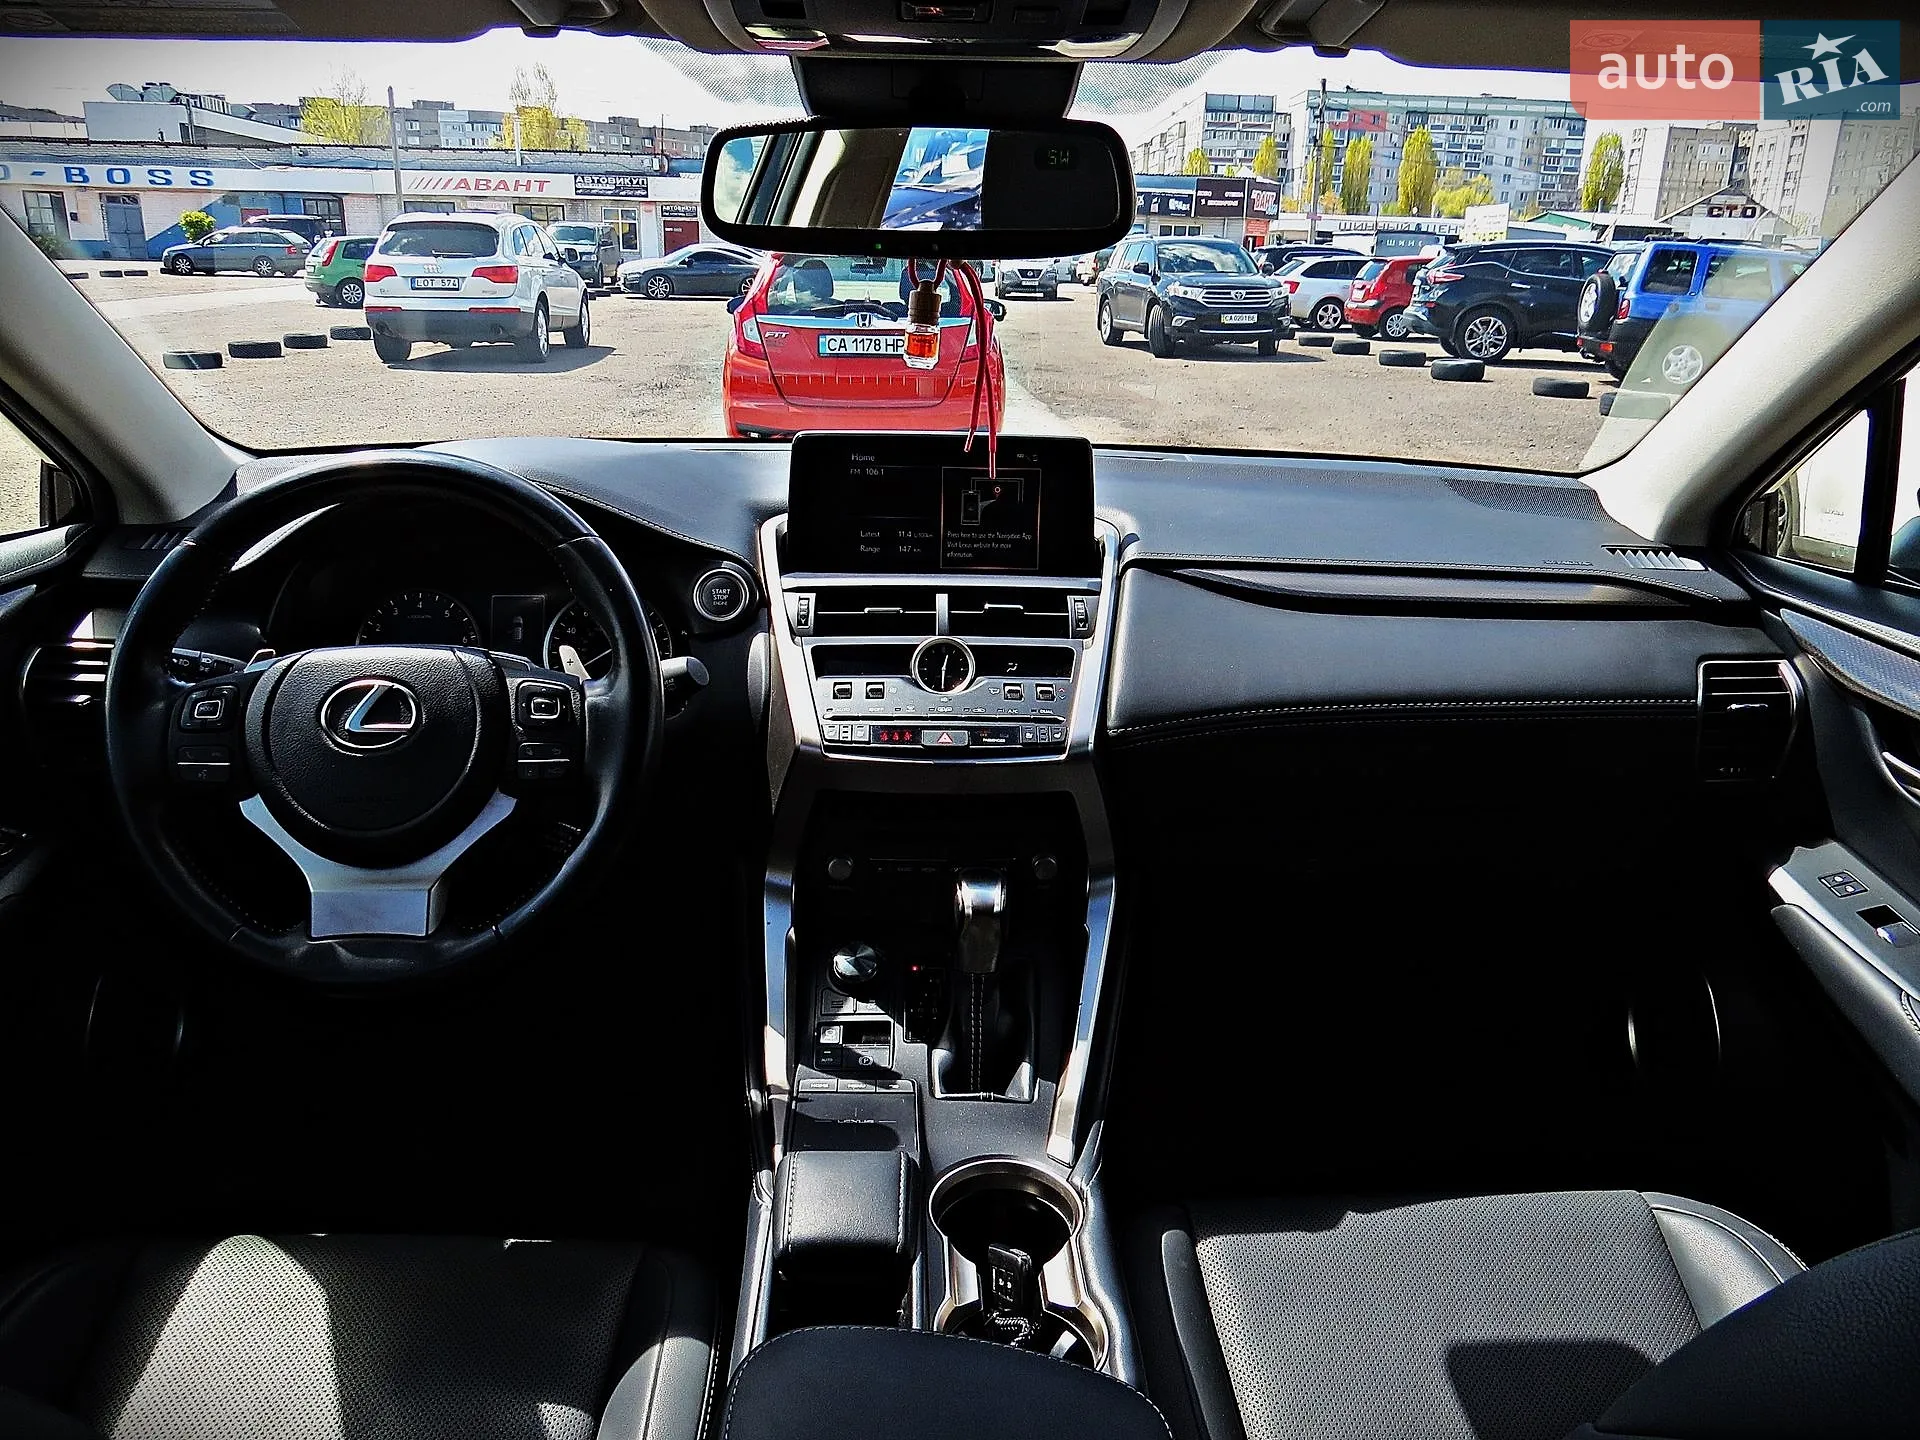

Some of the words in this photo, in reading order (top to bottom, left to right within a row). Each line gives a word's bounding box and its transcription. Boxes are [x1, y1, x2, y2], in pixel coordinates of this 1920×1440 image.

[453, 178, 551, 193] АВАНТ
[575, 175, 647, 186] АВТОВИКУП
[416, 279, 436, 287] LOT
[827, 338, 848, 352] CA
[852, 338, 881, 352] 1178
[885, 338, 905, 353] HP
[851, 453, 875, 462] Home
[860, 545, 880, 553] Range
